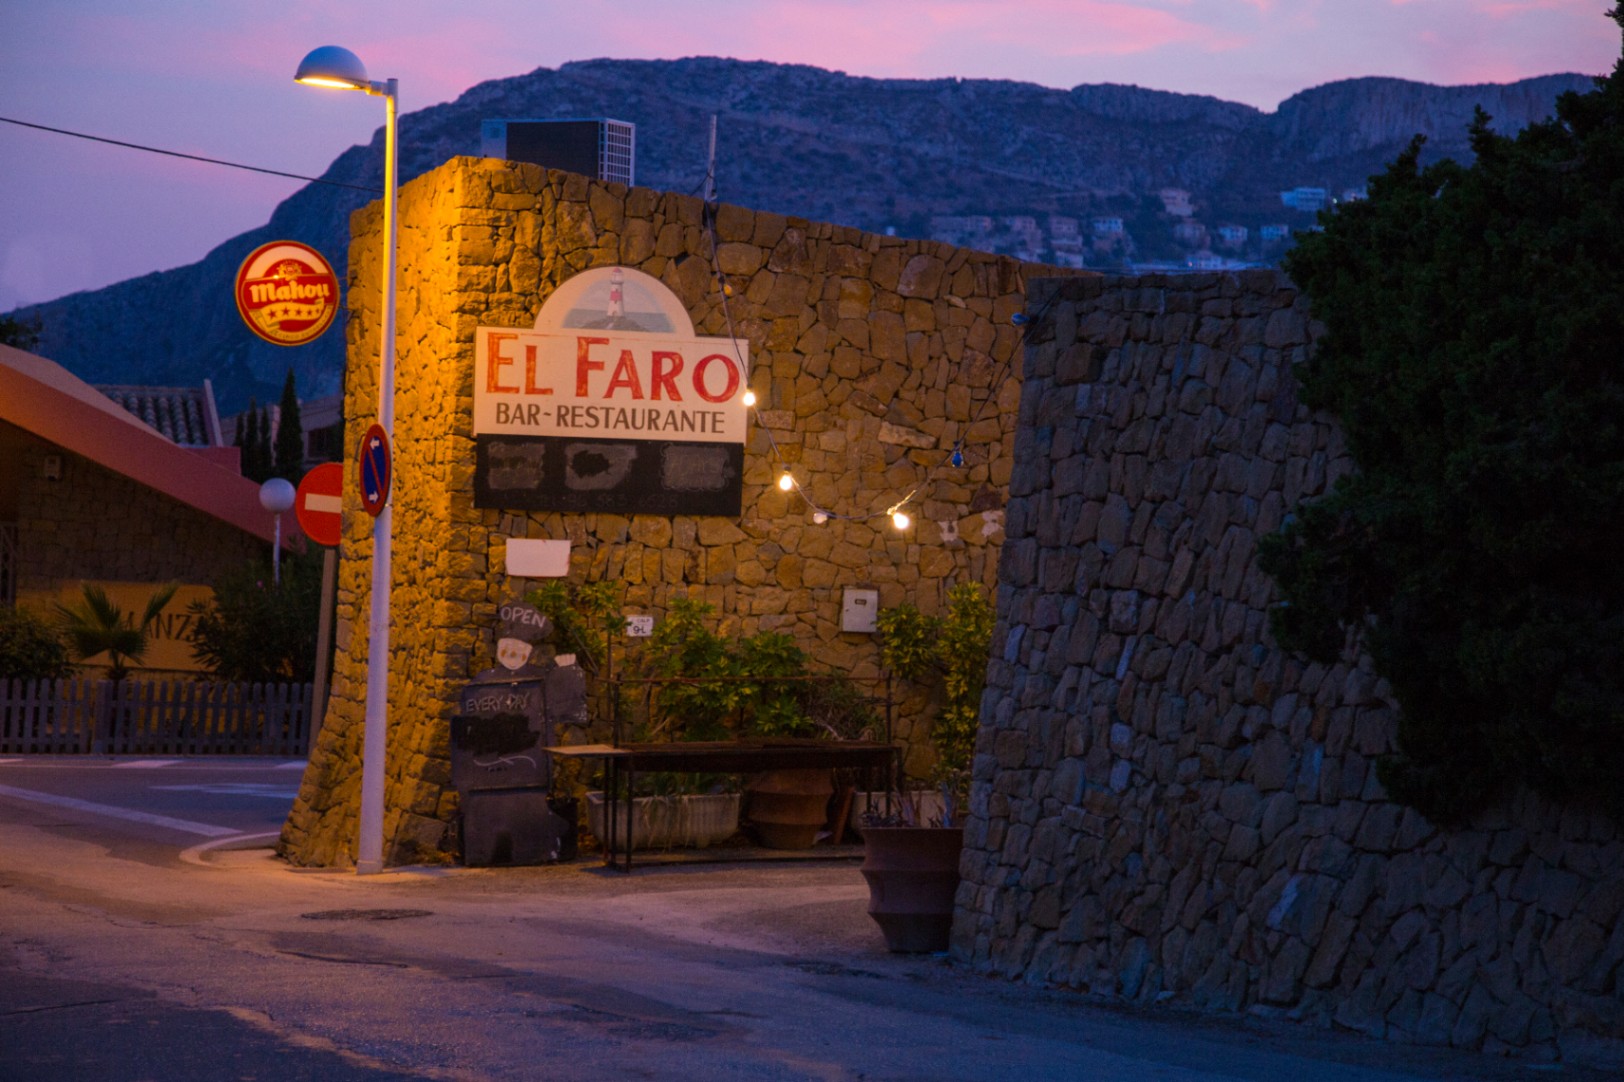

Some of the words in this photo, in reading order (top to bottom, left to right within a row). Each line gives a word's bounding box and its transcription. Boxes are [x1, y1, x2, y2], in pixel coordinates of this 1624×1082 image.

[249, 280, 330, 303] Mahou
[486, 331, 553, 395] EL
[575, 336, 740, 403] FARO
[500, 606, 547, 629] OPEN
[465, 694, 504, 714] EVERY
[508, 692, 530, 712] DAY
